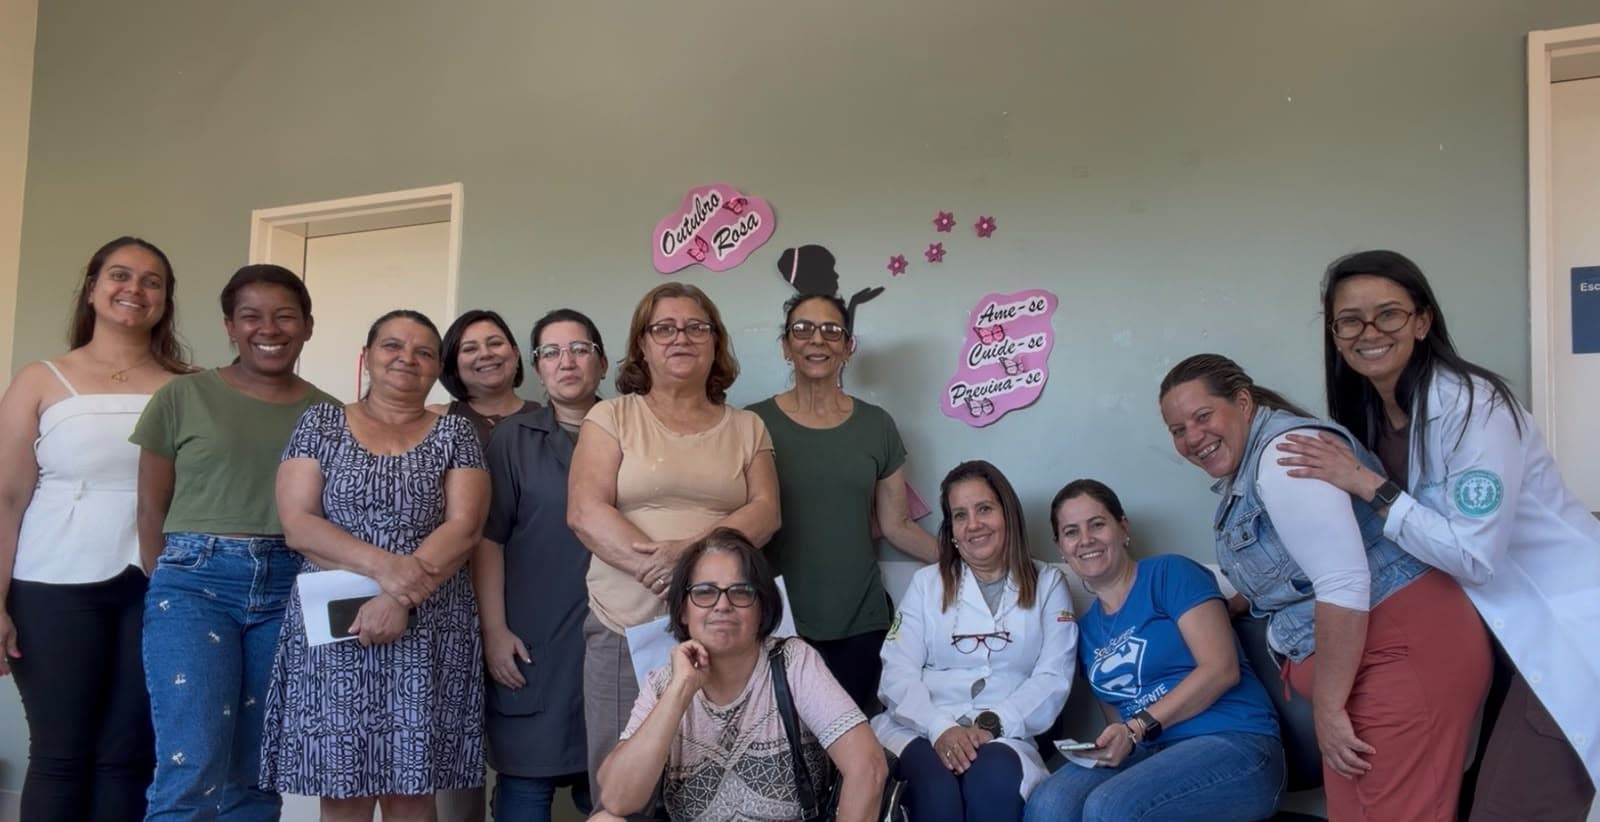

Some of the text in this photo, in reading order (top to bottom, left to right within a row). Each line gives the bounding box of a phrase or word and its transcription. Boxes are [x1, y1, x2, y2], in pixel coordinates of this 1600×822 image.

[663, 194, 719, 254] Outubro
[713, 214, 759, 256] Rosa
[978, 299, 1045, 325] Ame-se
[969, 336, 1043, 366] Cuide-se
[951, 372, 1041, 404] Previna-se
